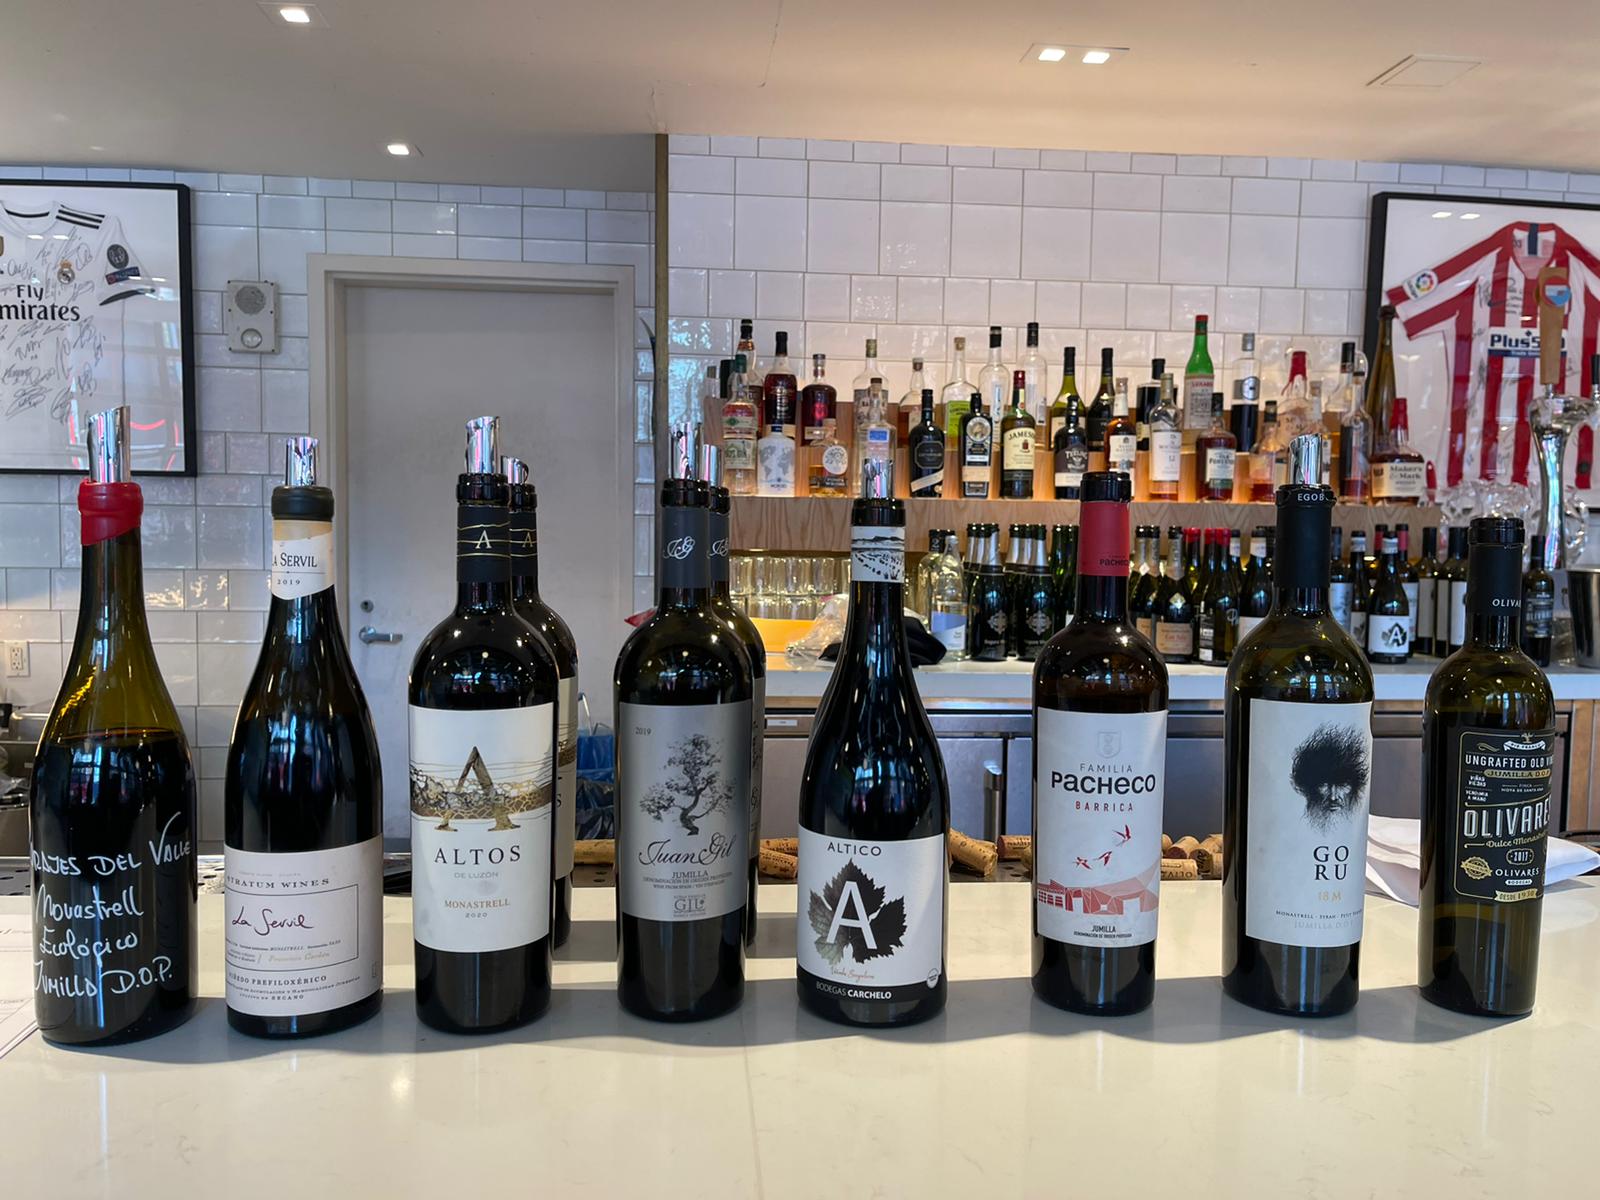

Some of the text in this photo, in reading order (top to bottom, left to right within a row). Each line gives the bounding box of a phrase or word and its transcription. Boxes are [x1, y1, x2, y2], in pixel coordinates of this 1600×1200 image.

[16, 284, 44, 302] Fly
[0, 302, 80, 321] mirates
[475, 530, 492, 549] A
[280, 552, 318, 568] SERVIL
[1080, 763, 1133, 774] FAMILIA
[1465, 754, 1527, 769] UNGRAFTED
[1530, 757, 1545, 768] OLD
[1487, 770, 1534, 778] JUMILLA
[1075, 800, 1133, 812] BARRICA
[638, 839, 699, 866] Juan
[698, 832, 737, 866] Gil
[827, 842, 882, 857] ALTICO
[1486, 840, 1512, 848] Dulce
[434, 845, 521, 866] ALTOS
[1313, 845, 1349, 863] GO
[87, 853, 142, 876] DEL
[1314, 863, 1348, 881] RU
[1495, 867, 1540, 877] OLIVARES
[672, 870, 709, 879] JUMILLA
[281, 878, 330, 889] WINES
[444, 898, 511, 909] MONASTRELL
[232, 906, 314, 936] La Servil
[826, 880, 878, 950] A
[1276, 910, 1314, 919] MONASTRELL
[1092, 925, 1116, 933] JUMILLA
[252, 974, 327, 987] PREFILOXÉRICO
[816, 982, 892, 1000] BODEGAS CARCHELO
